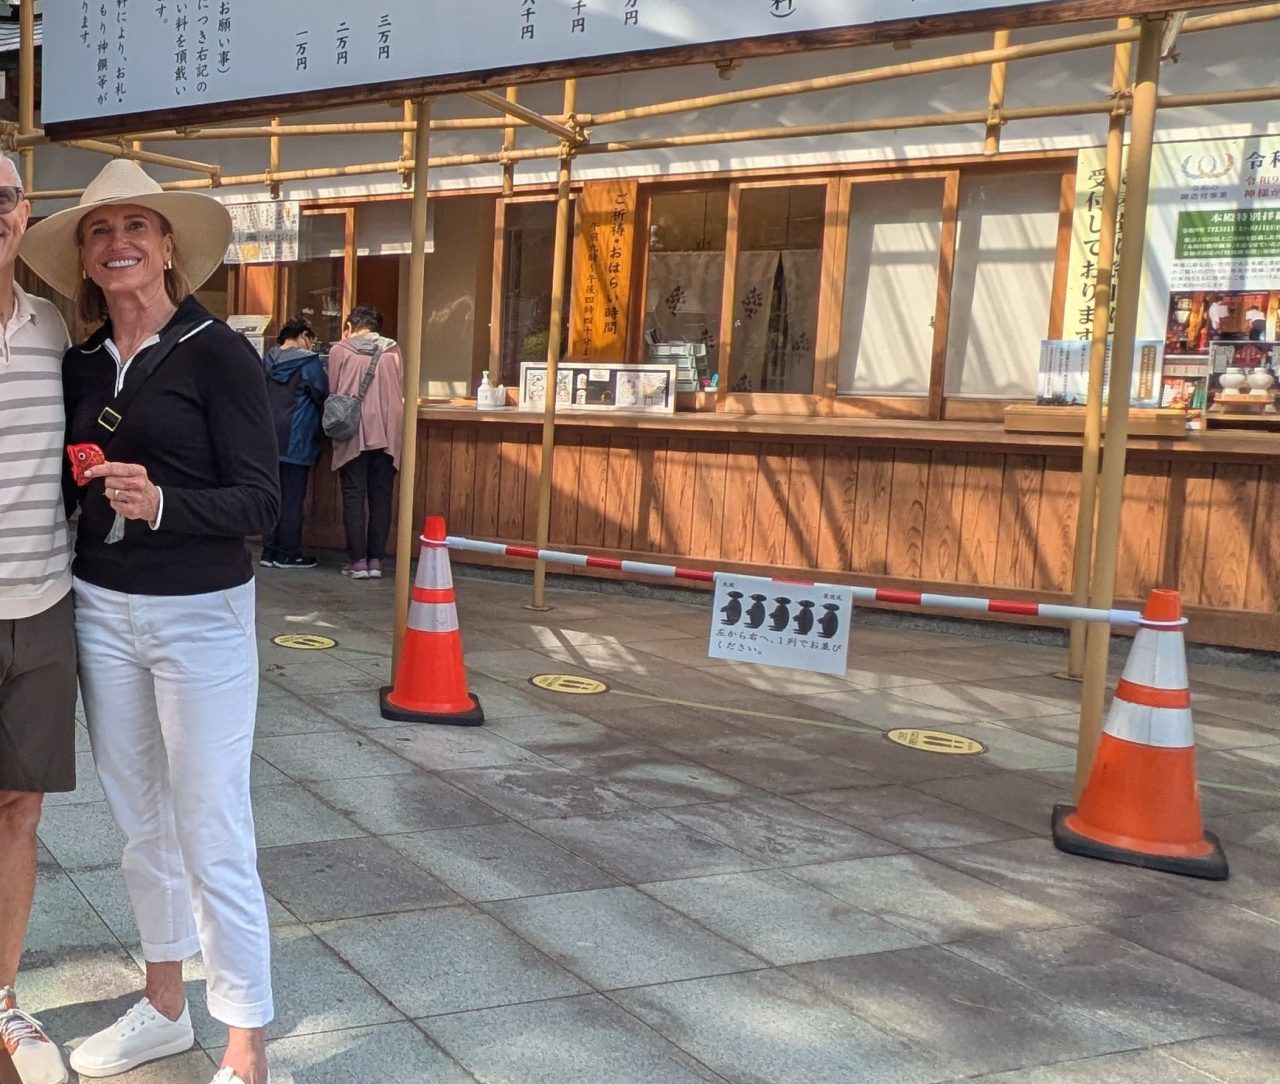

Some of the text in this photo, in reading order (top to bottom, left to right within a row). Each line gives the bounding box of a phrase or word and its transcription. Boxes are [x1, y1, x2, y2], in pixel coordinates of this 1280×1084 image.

[196, 0, 209, 92] につき右記の
[295, 30, 308, 71] 一万円
[336, 21, 350, 65] 二万円
[378, 14, 393, 60] 三万円
[717, 641, 762, 655] ください。
